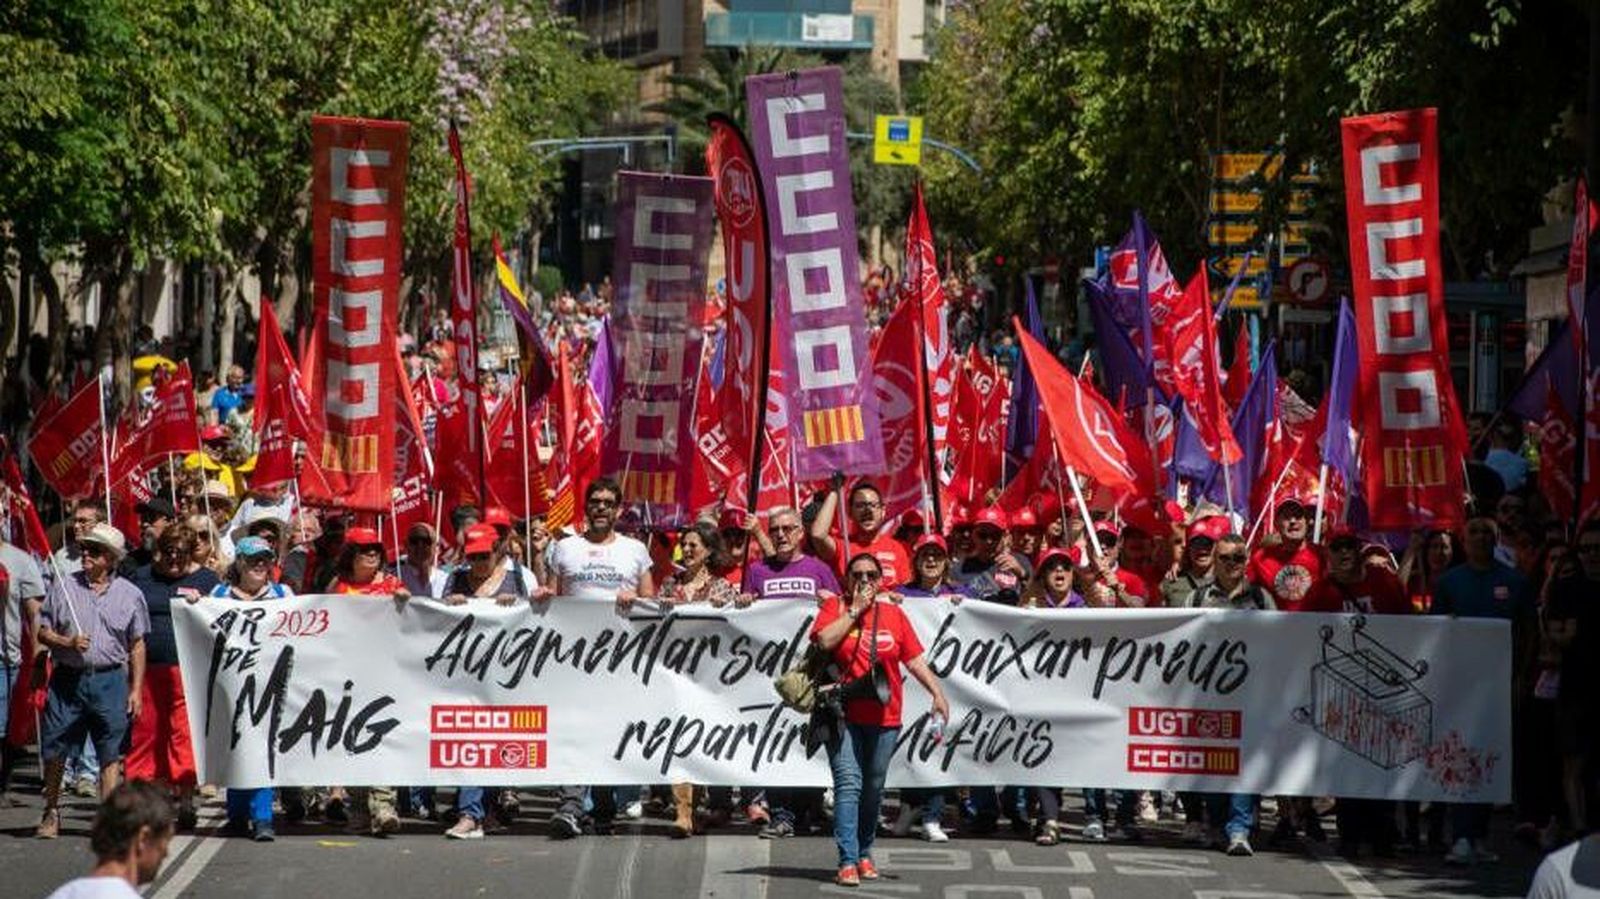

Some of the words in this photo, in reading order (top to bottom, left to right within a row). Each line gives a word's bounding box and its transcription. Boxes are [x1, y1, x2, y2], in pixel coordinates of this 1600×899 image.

[766, 93, 857, 390] CCOO
[325, 147, 391, 421] CCOO
[1361, 143, 1441, 430] CCOO
[619, 196, 697, 454] CCOO
[767, 580, 813, 593] CCOO
[269, 608, 330, 637] 2023
[222, 647, 261, 673] DE
[424, 613, 729, 690] Augmentar
[1092, 636, 1249, 701] preus
[436, 711, 510, 729] CCOO
[1137, 710, 1194, 735] UGT
[439, 742, 498, 767] UGT
[1132, 748, 1206, 769] CCOO
